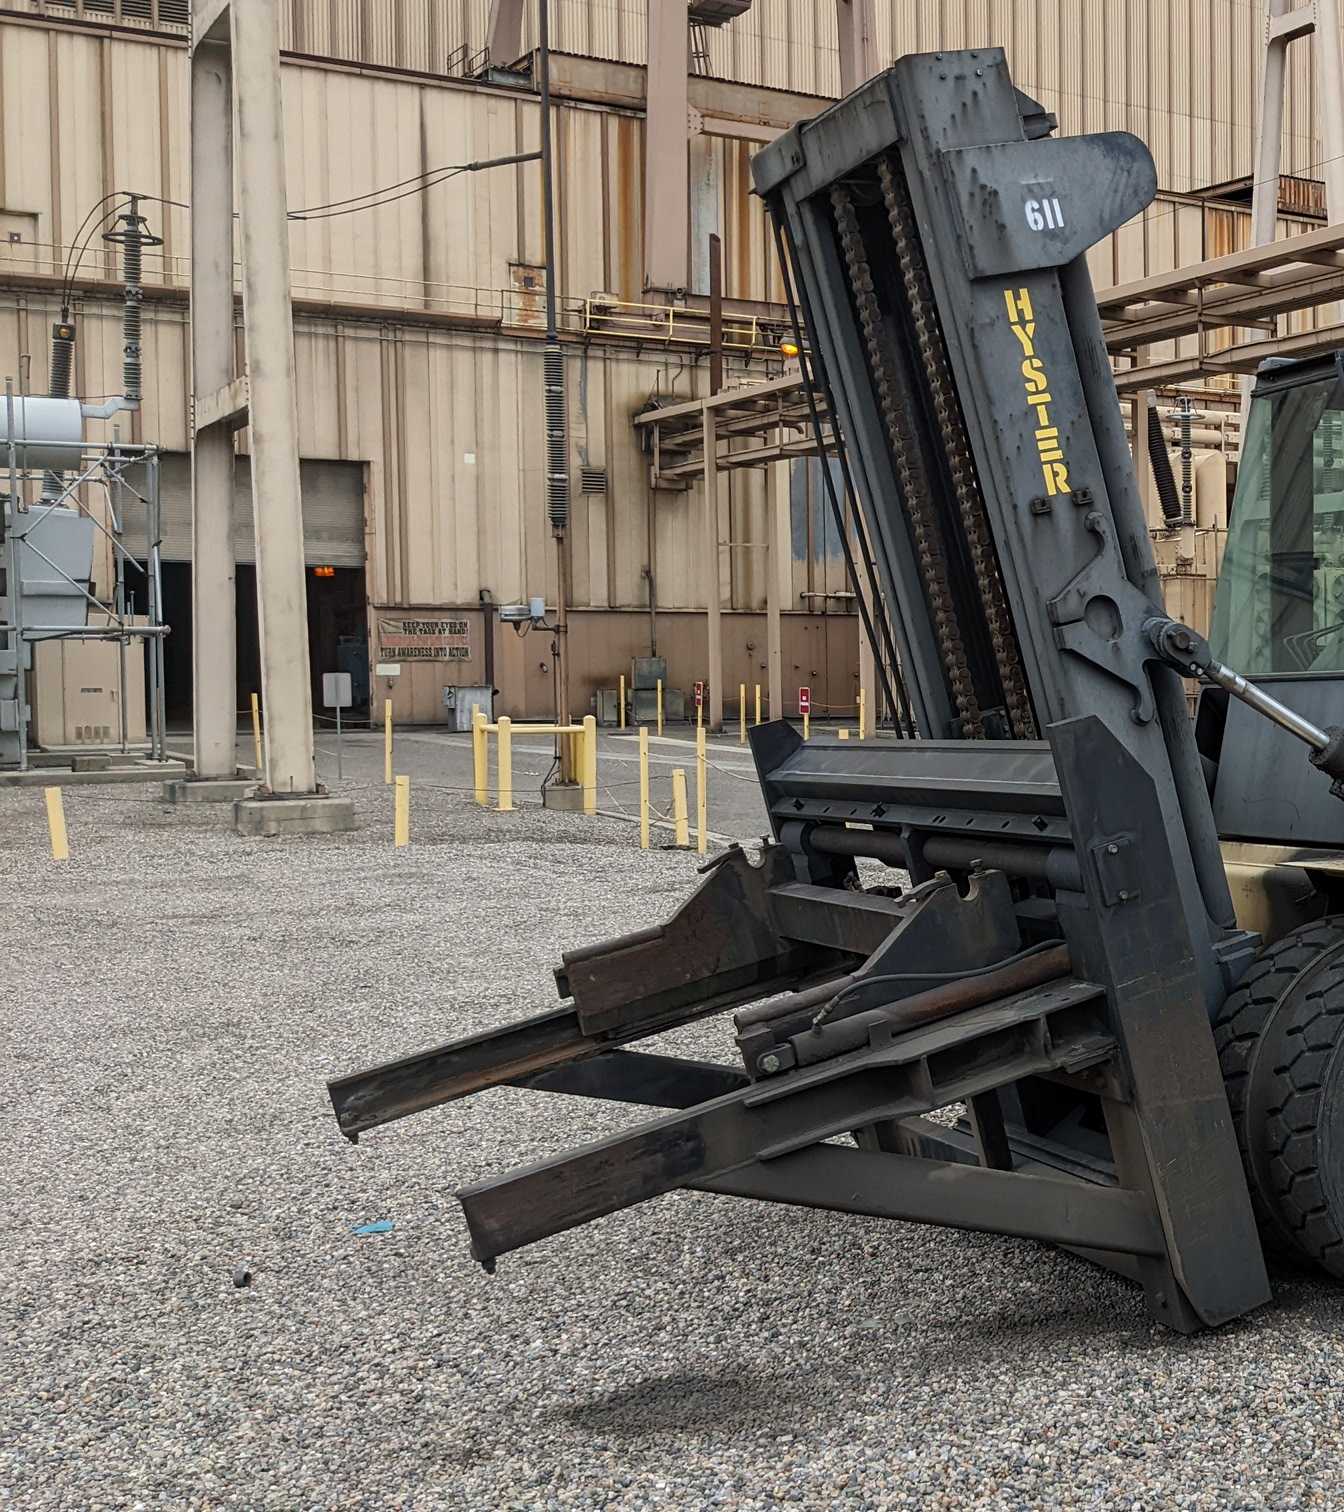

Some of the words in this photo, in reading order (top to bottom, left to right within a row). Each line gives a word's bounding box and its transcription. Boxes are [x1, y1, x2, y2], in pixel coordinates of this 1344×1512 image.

[1024, 198, 1065, 231] 611
[1003, 287, 1072, 496] HYSTER
[381, 647, 396, 657] TURN
[397, 647, 433, 657] AWARENESS
[434, 647, 447, 657] INTO
[448, 647, 469, 657] ACTION
